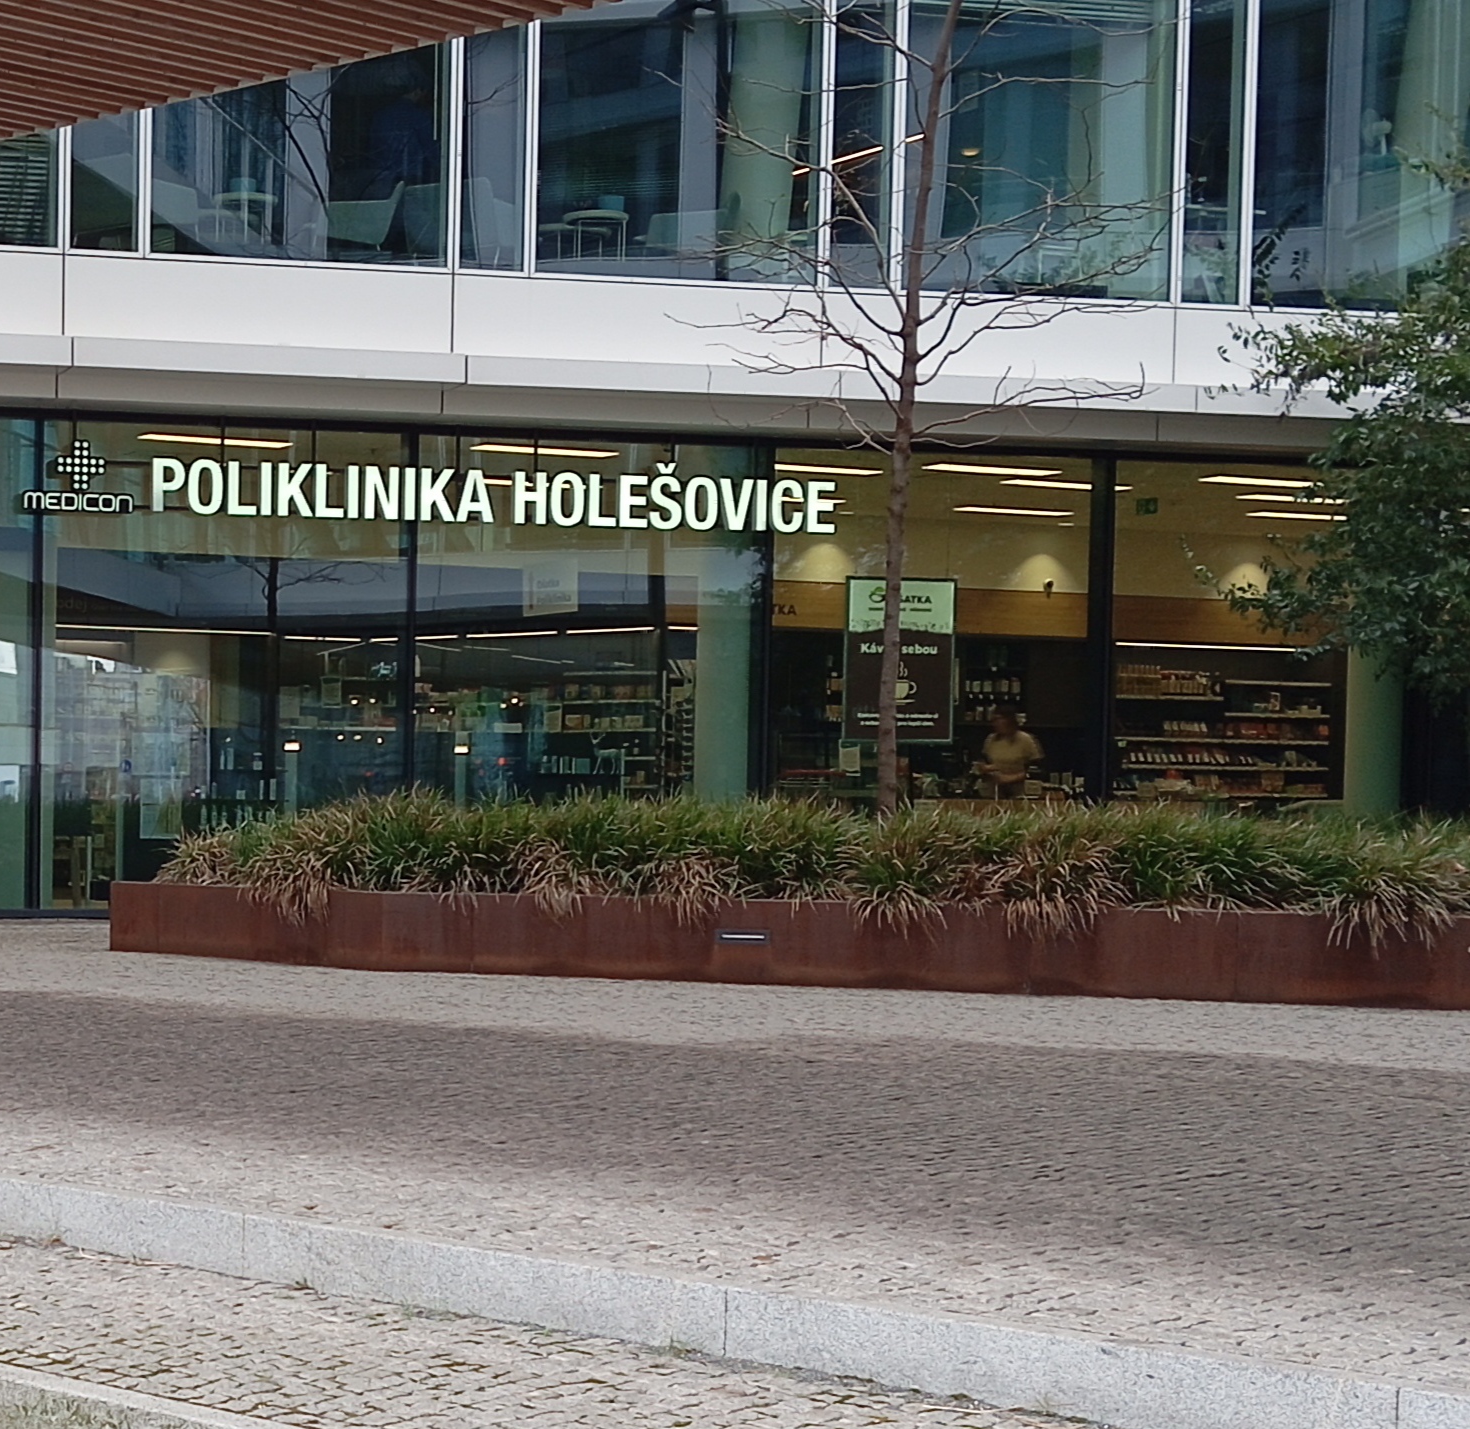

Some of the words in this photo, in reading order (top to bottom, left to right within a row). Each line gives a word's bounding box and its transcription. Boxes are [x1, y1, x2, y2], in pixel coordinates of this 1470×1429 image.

[23, 491, 133, 513] MEDICON
[151, 457, 494, 523] POLIKLINIKA
[513, 462, 836, 534] HOLEŠOVICE
[860, 642, 885, 654] Káv
[901, 643, 939, 655] sebou
